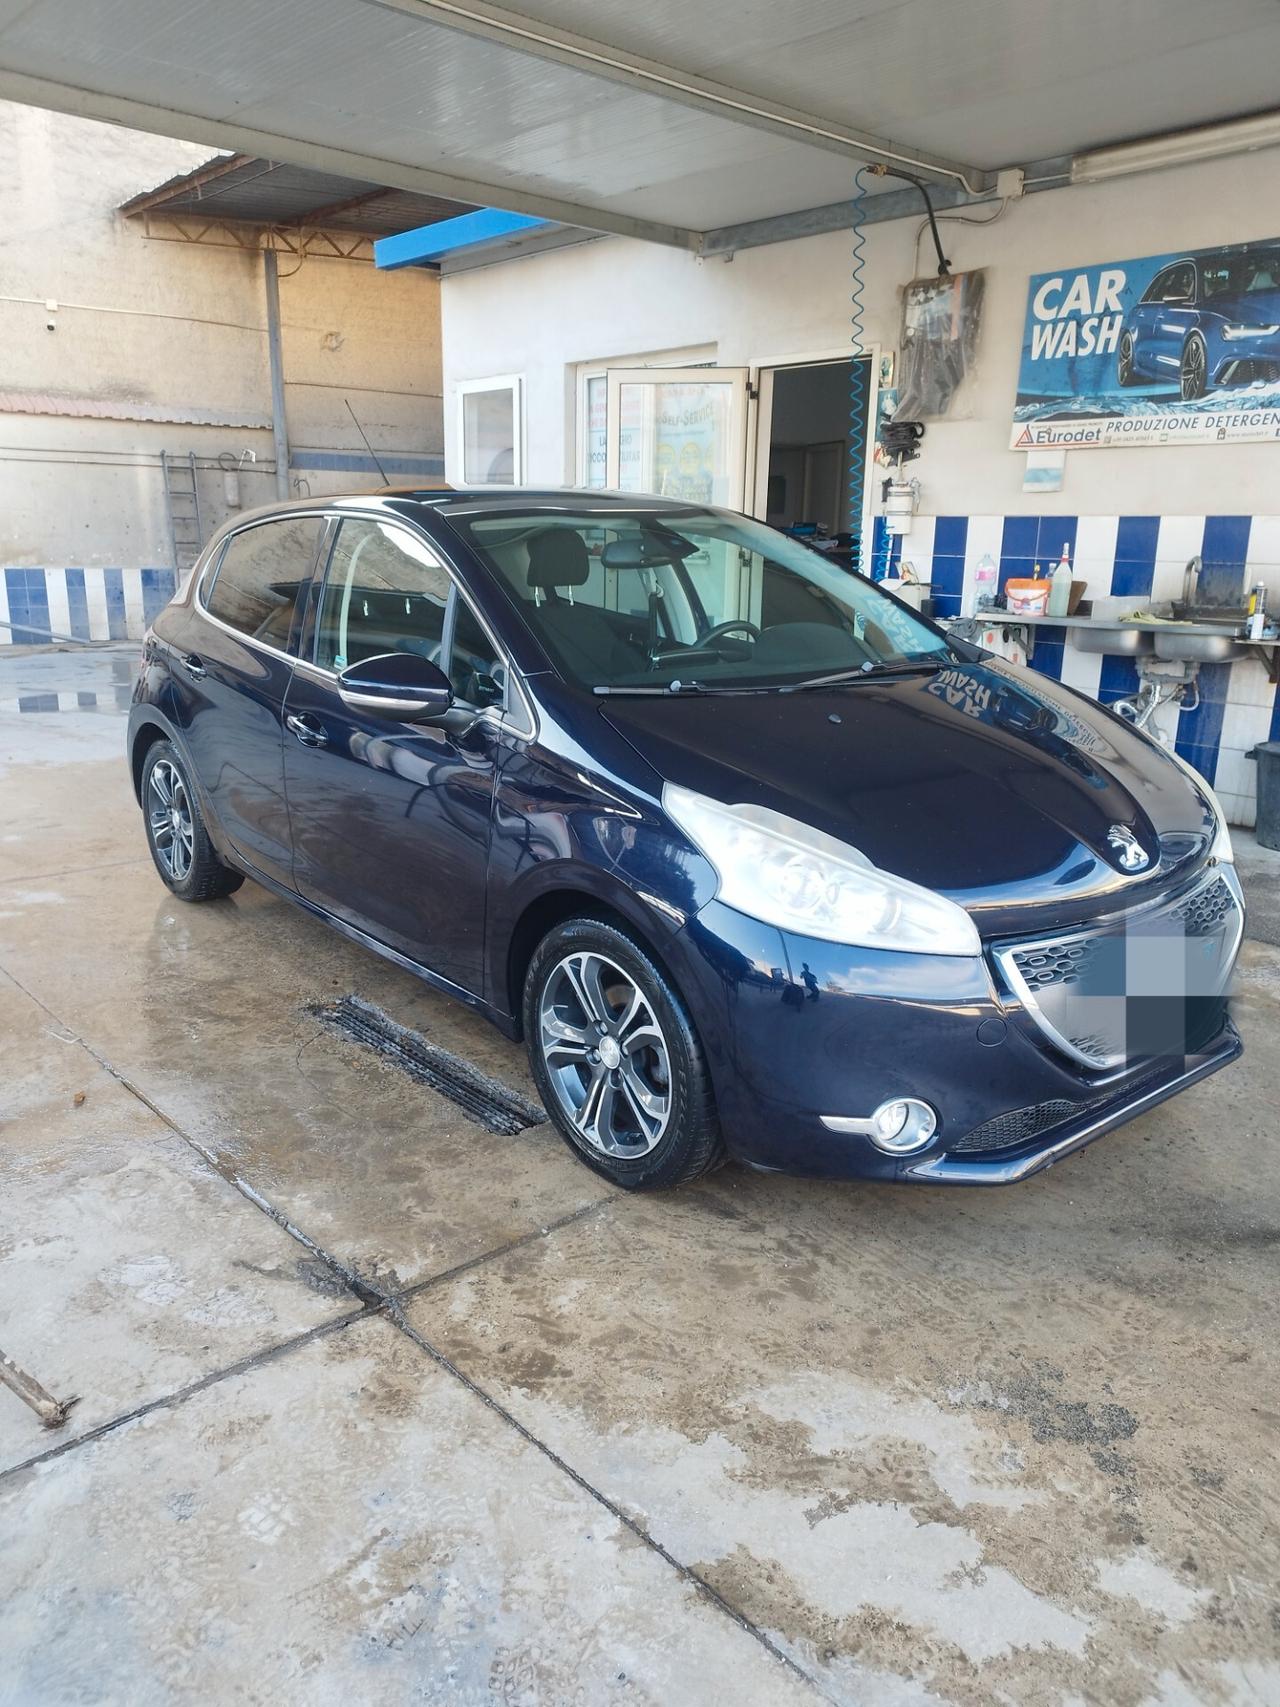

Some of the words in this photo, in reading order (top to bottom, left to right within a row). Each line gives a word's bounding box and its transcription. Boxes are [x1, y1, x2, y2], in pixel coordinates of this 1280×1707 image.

[1033, 270, 1126, 320] CAR
[1031, 315, 1124, 360] WASH
[1036, 428, 1102, 444] Eurodet
[1106, 417, 1200, 433] PRODUZIONE
